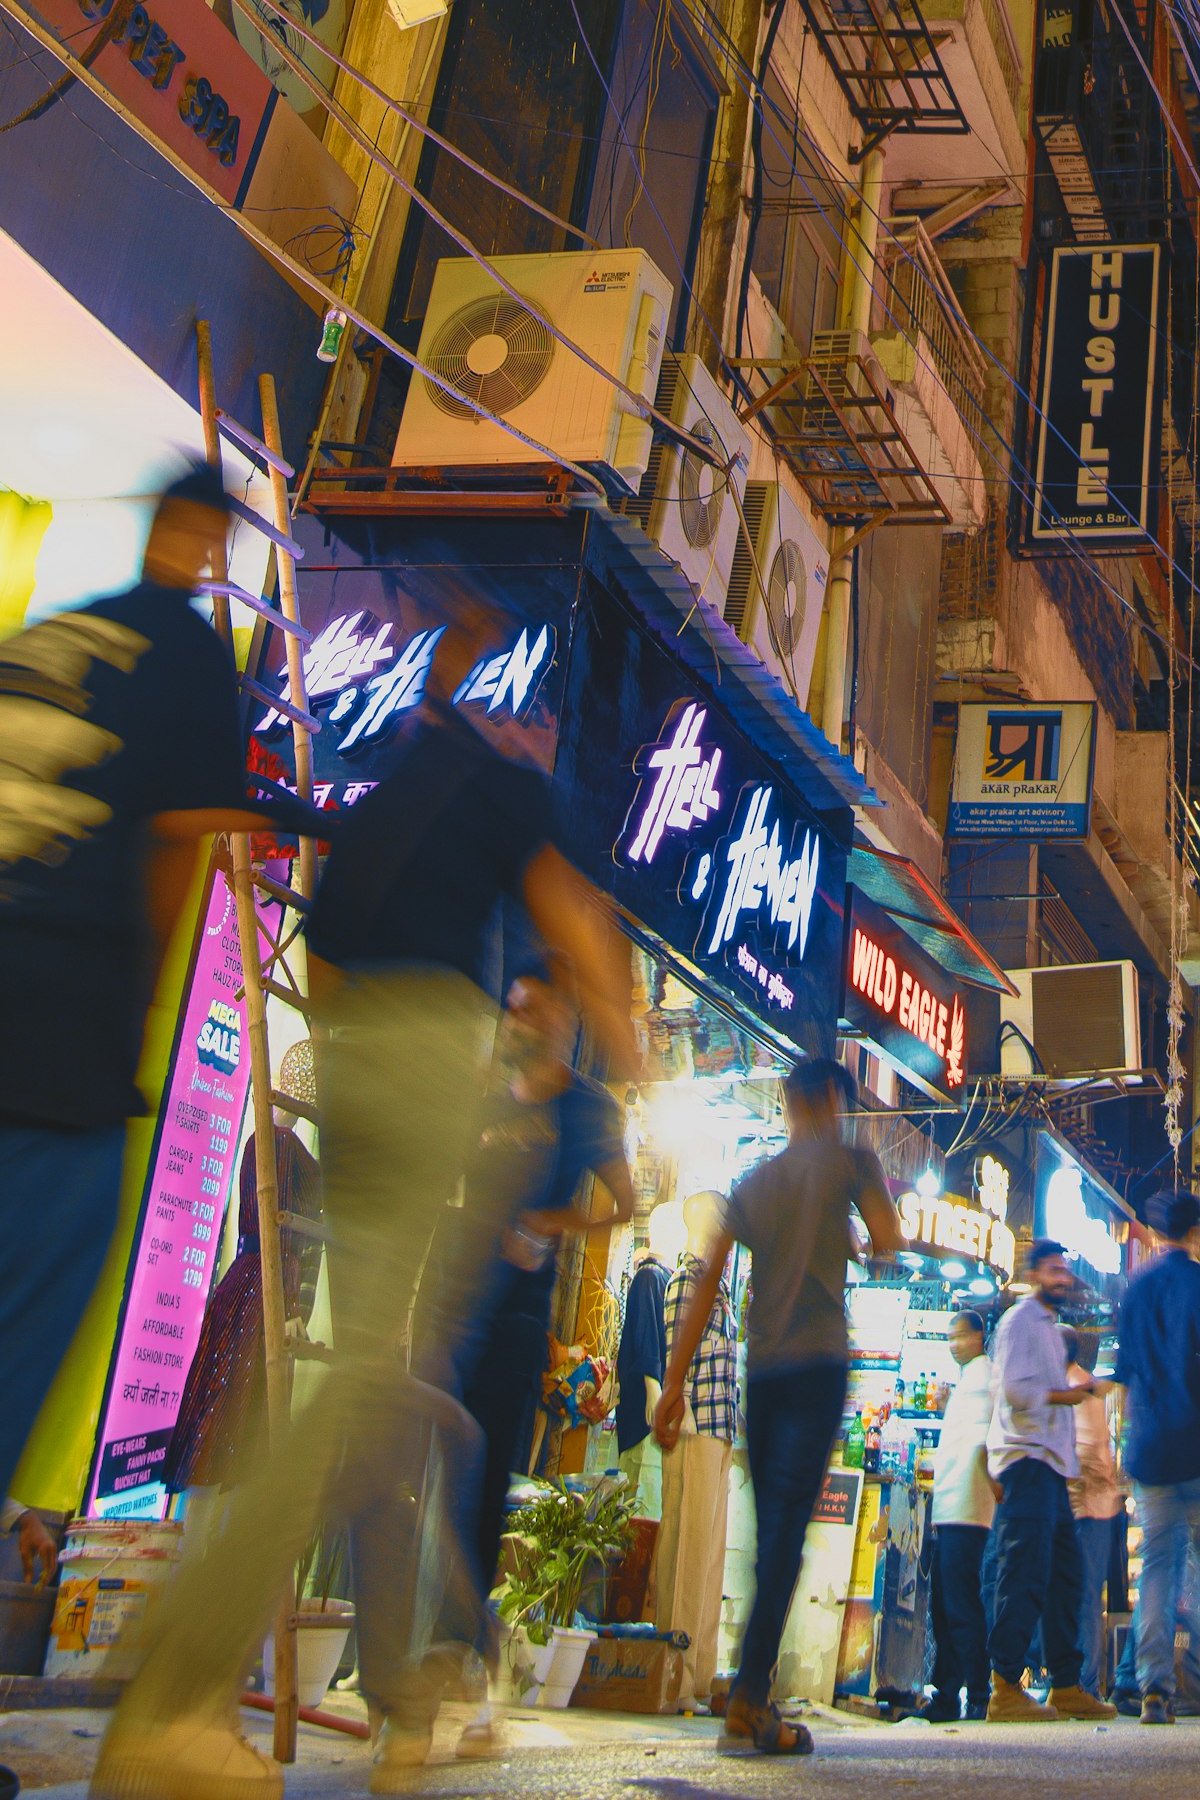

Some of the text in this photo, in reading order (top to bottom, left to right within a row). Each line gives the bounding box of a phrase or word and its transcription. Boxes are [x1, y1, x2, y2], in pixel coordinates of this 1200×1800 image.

[112, 1, 187, 90] PET
[178, 76, 241, 168] SPA
[1076, 252, 1124, 507] HUSTLE
[1050, 512, 1128, 526] Lounge & Bar
[969, 807, 1066, 817] akar prakar art advisory
[852, 928, 897, 1014] WILD
[899, 970, 949, 1059] EAGLE
[207, 998, 242, 1033] MEGA
[196, 1021, 241, 1066] SALE
[209, 1113, 215, 1129] 3
[216, 1115, 232, 1136] FOR
[209, 1135, 229, 1155] 1199
[165, 1158, 221, 1197] JEANS 2099
[201, 1155, 207, 1171] 3
[207, 1157, 224, 1178] FOR
[159, 1190, 215, 1223] PARACHUTE 2 FOR
[156, 1205, 212, 1242] PANTS 1999
[183, 1245, 189, 1262] 2
[190, 1248, 206, 1269] FOR
[147, 1251, 204, 1288] SET 1799
[142, 1318, 184, 1340] AFFORDABLE
[133, 1346, 184, 1370] FASHION STORE
[133, 1493, 158, 1512] WATCHES
[822, 1490, 849, 1502] Eagle
